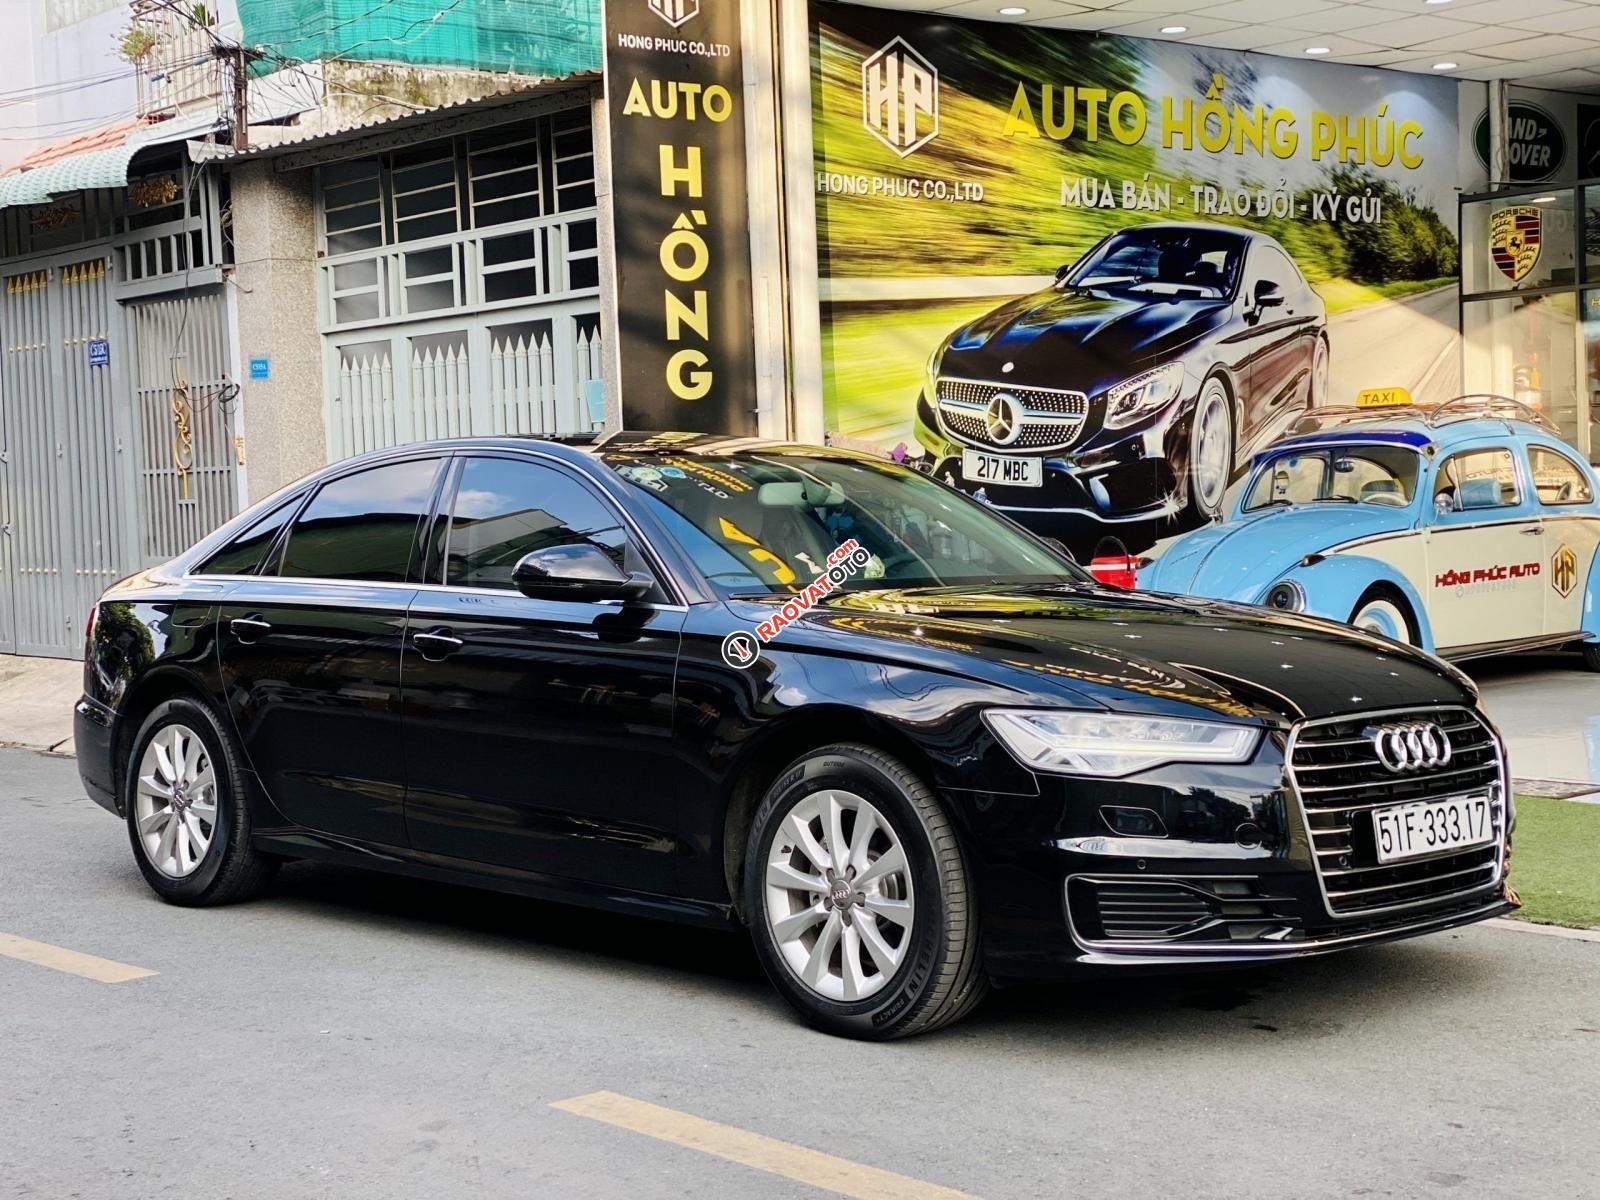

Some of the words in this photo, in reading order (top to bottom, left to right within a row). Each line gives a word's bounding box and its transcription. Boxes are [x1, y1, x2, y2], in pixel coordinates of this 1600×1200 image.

[618, 33, 652, 50] HONG
[655, 38, 687, 53] PHUC
[689, 41, 730, 57] CO.,LTD
[622, 77, 733, 122] AUTO
[1003, 81, 1147, 145] AUTO
[1162, 73, 1298, 159] HỒNG
[1311, 103, 1424, 169] PHÚC
[1508, 117, 1537, 141] ND
[1509, 142, 1551, 167] OVER
[817, 173, 868, 195] HONG
[872, 177, 920, 200] PHUC
[923, 180, 984, 203] CO.,LTD
[1060, 175, 1115, 209] MUA
[1122, 173, 1171, 211] BÁN
[1190, 185, 1250, 216] TRAO
[1256, 177, 1295, 219] ĐỔI
[1312, 187, 1341, 221] KÝ
[1346, 187, 1381, 223] GỬI
[1491, 208, 1539, 222] PORSCHE
[1362, 391, 1394, 404] TAXI
[977, 456, 1000, 479] 217
[1003, 460, 1028, 481] MBC
[1473, 565, 1507, 582] PHÚC
[1509, 562, 1540, 578] AUTO
